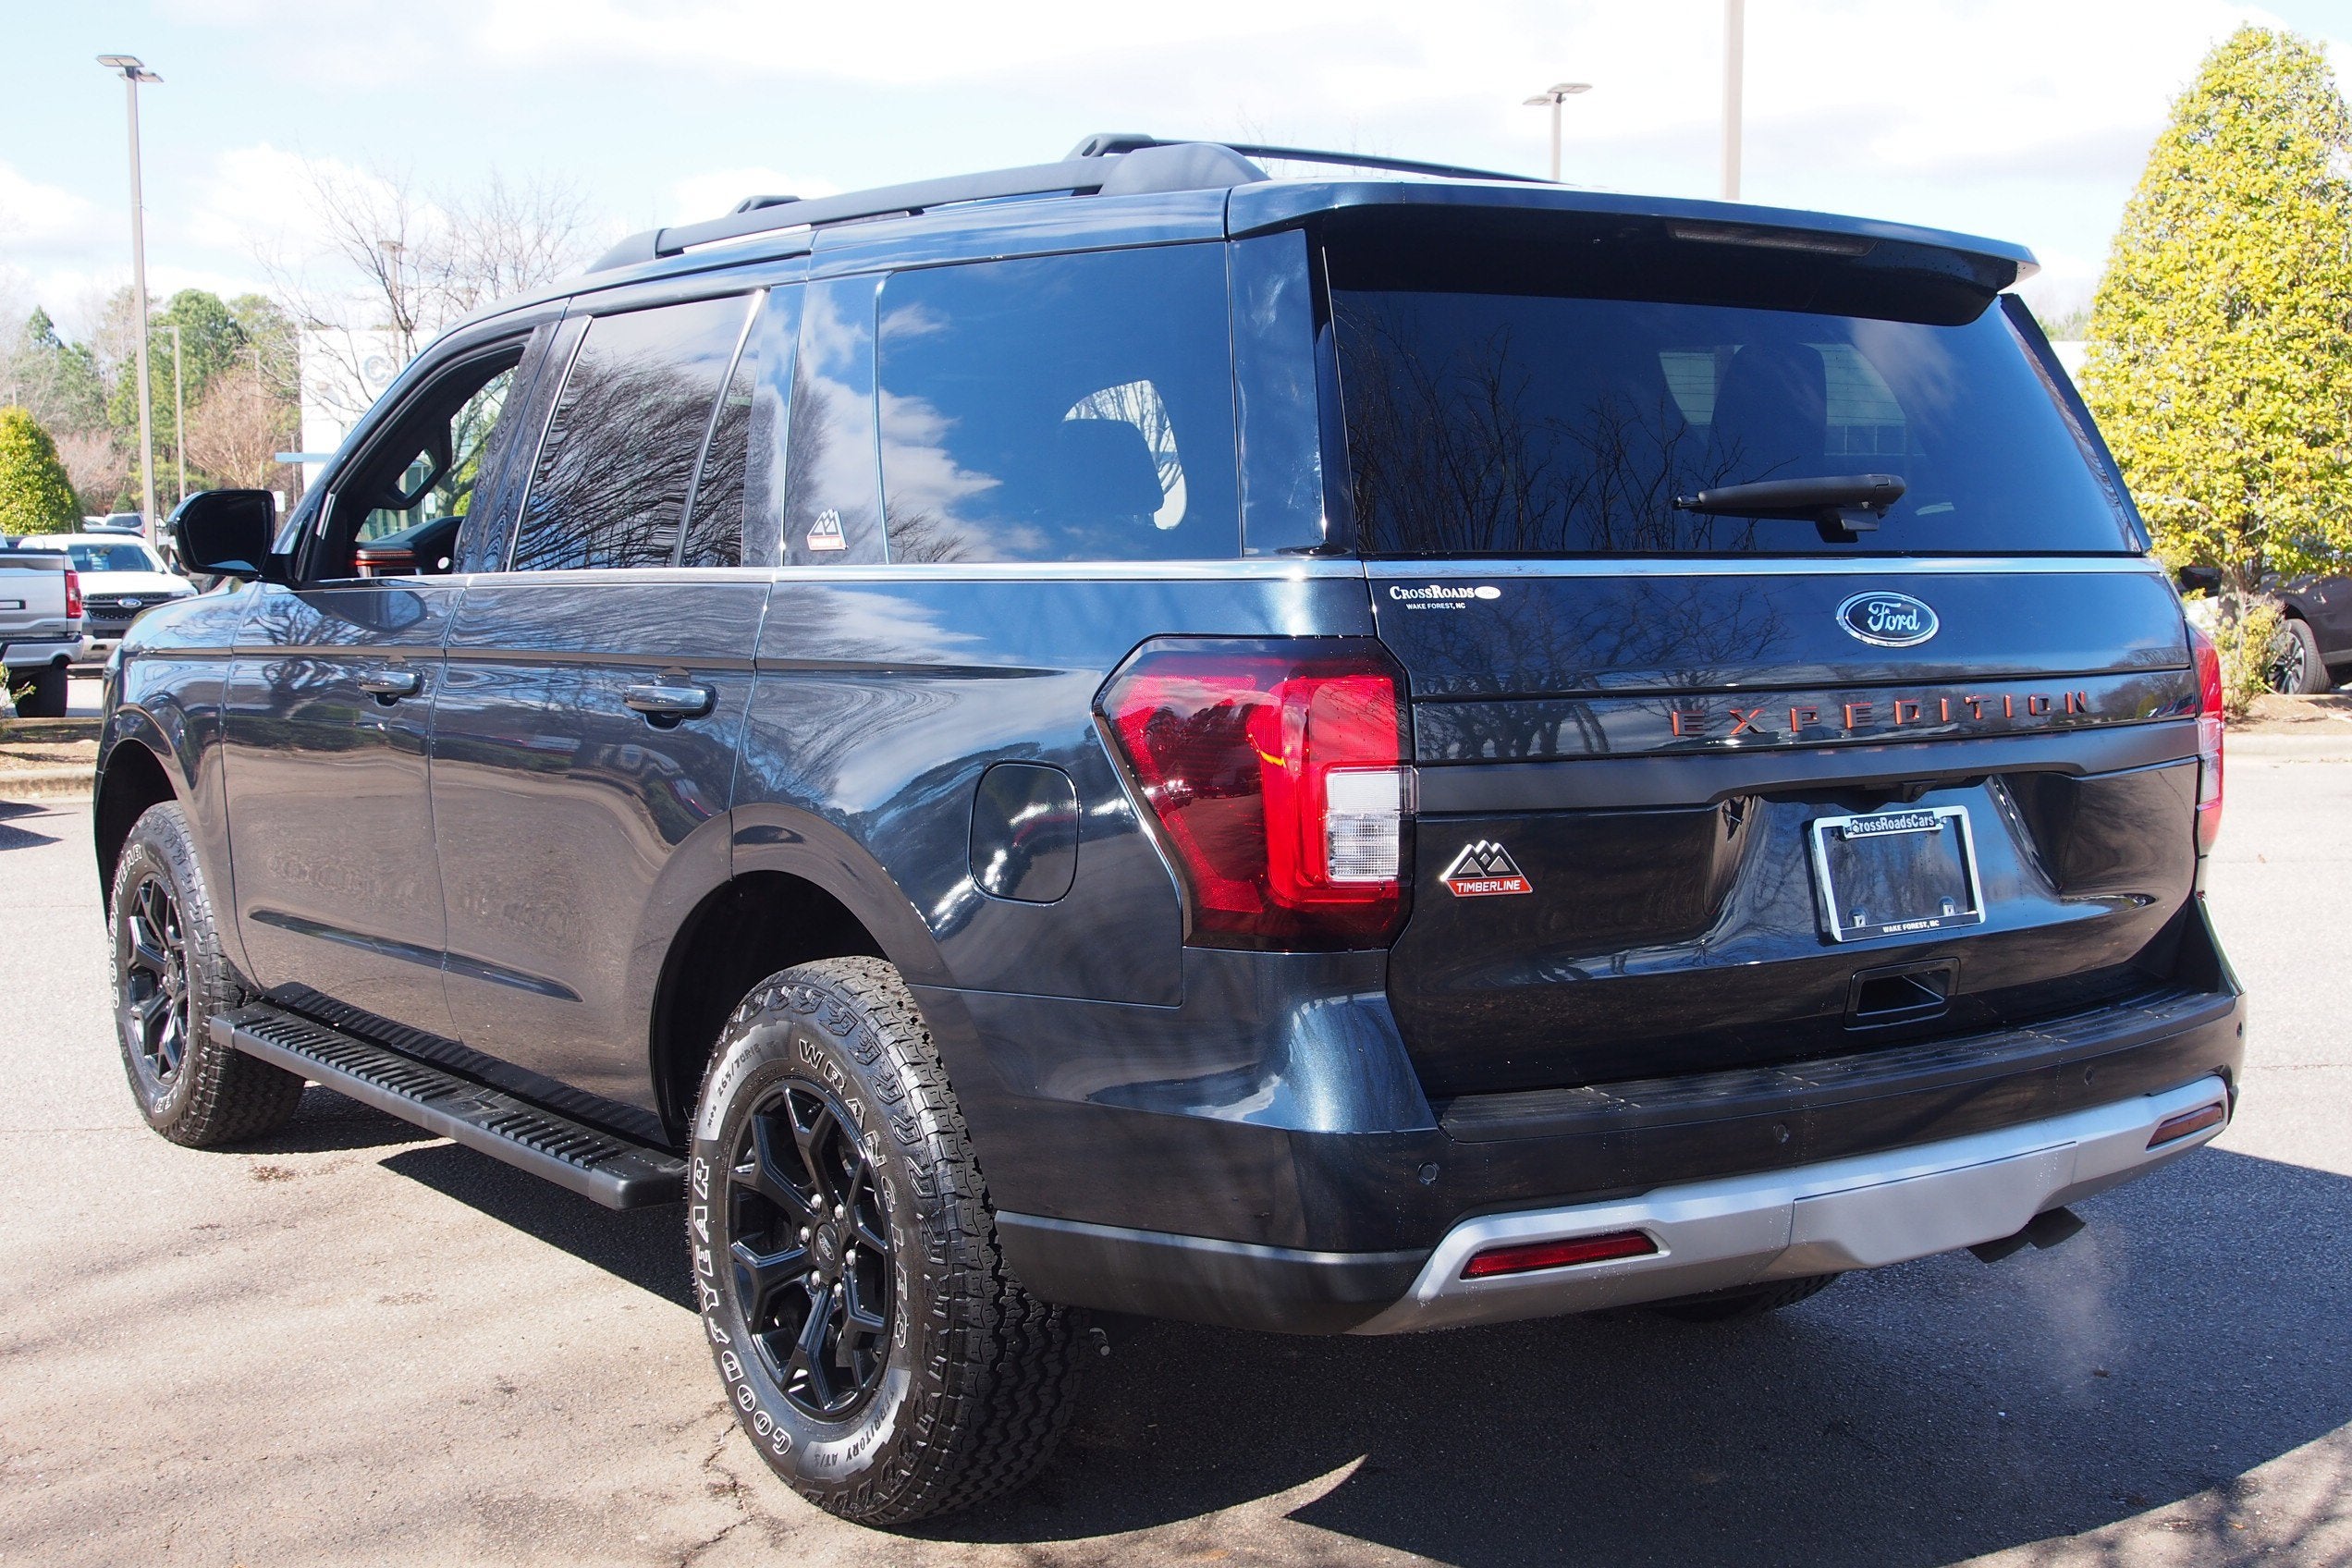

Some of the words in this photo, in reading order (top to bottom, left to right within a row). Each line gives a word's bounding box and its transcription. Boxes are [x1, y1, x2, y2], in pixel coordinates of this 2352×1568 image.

[1427, 602, 1455, 610] FOREST,
[1868, 601, 1920, 631] Ford
[1672, 691, 2087, 737] EXPEDITION
[1456, 879, 1521, 893] TIMBERLINE
[1882, 924, 1902, 934] WAKE
[1903, 921, 1929, 931] FOREST,
[1930, 919, 1940, 927] NC
[798, 1038, 909, 1349] WRANGLER
[693, 1157, 791, 1445] GOODYEAR
